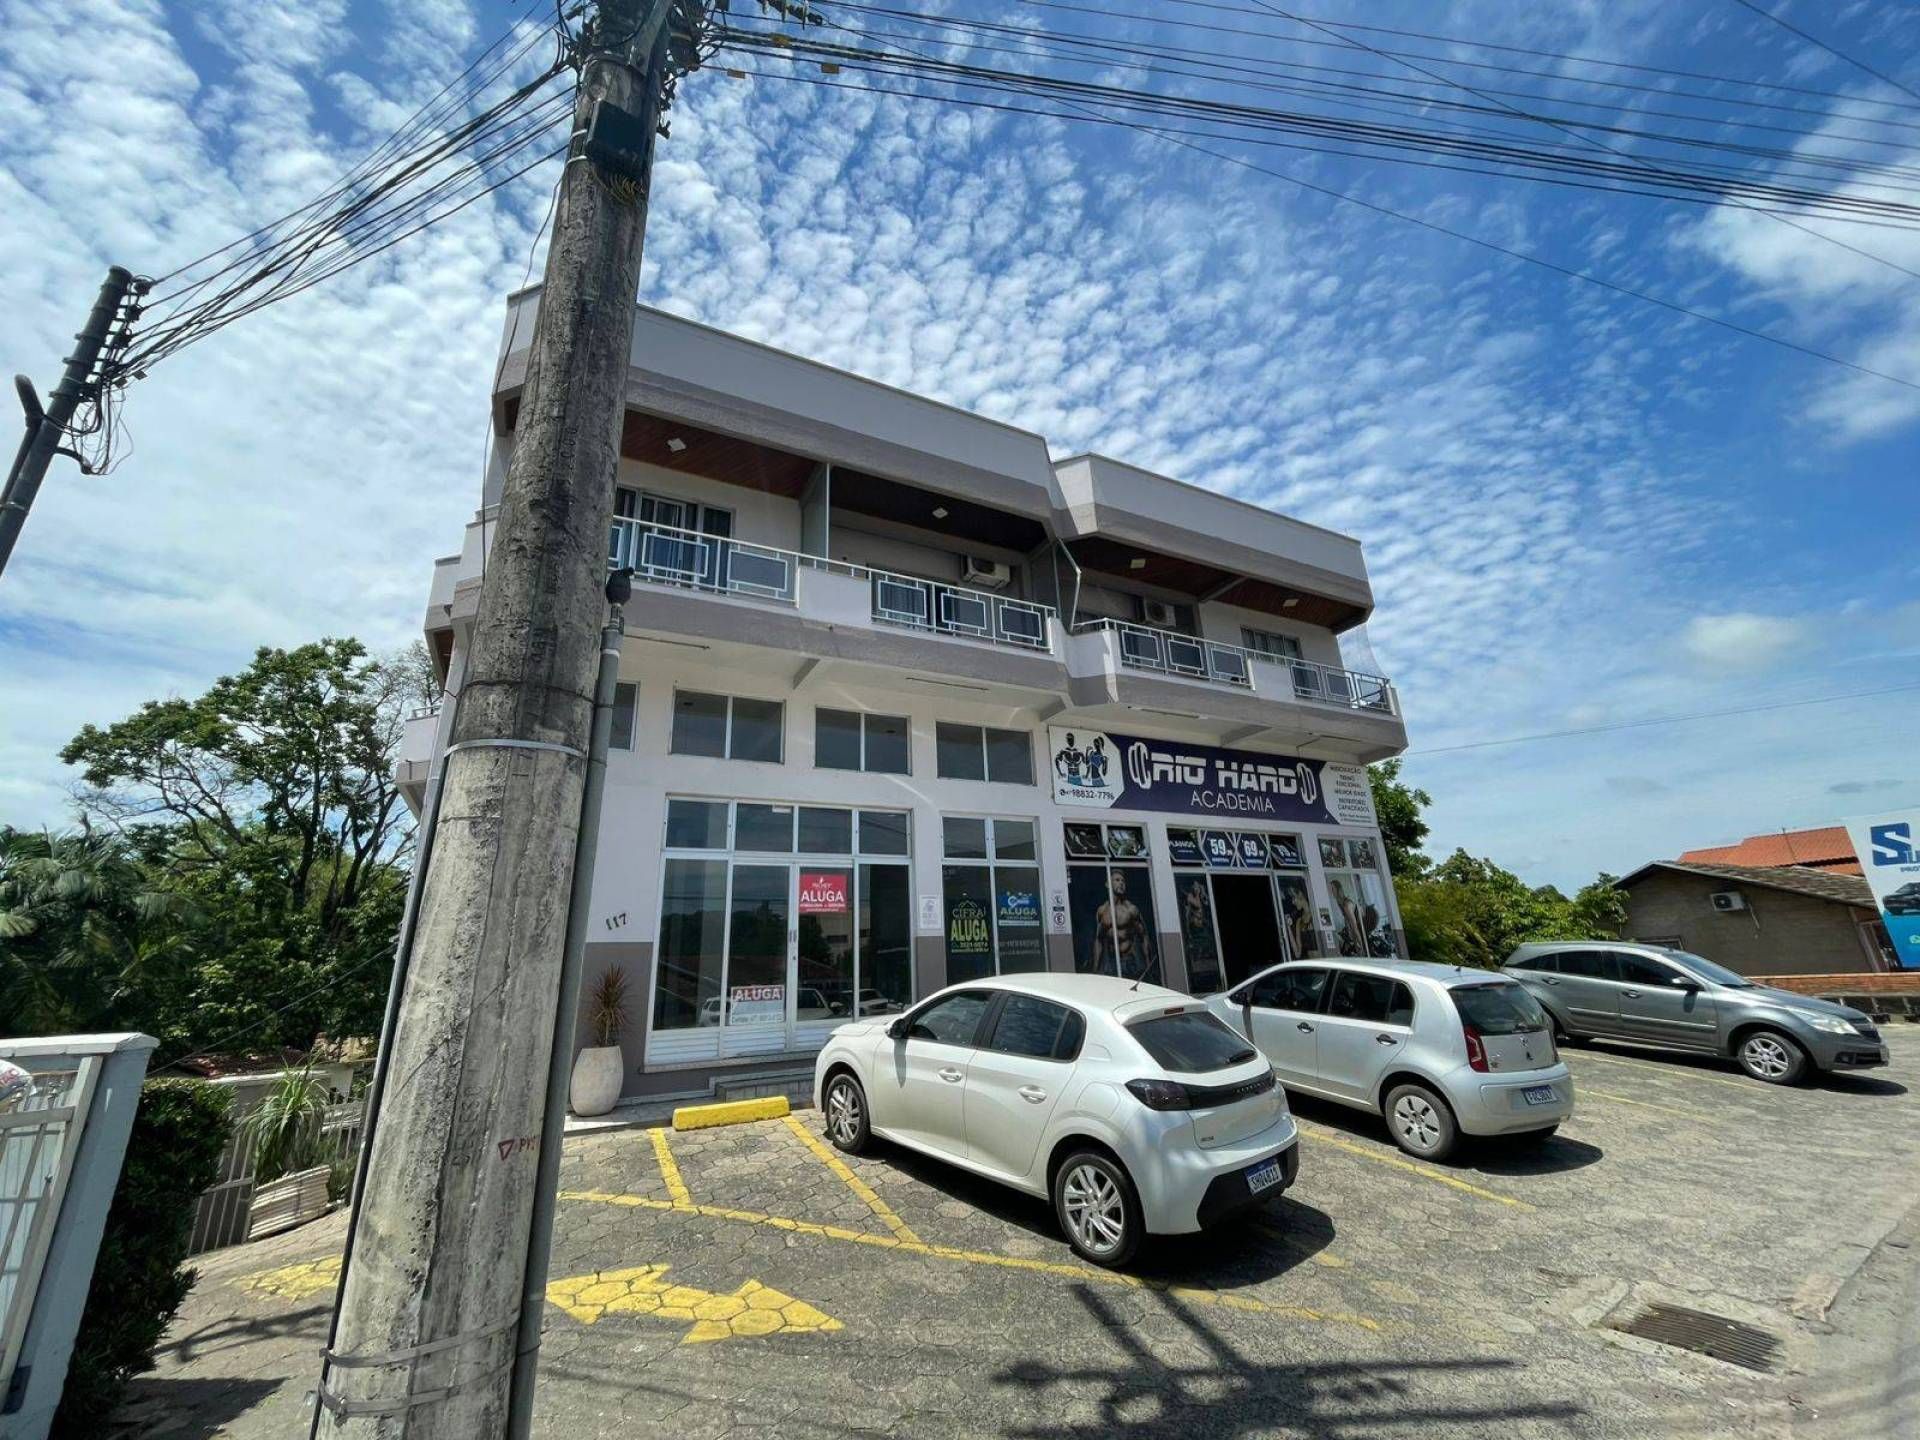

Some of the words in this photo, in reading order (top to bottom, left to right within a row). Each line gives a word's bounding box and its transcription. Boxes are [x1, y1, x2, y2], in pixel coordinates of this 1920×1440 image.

[1151, 752, 1206, 786] RIO
[1215, 760, 1298, 795] HARD
[1190, 790, 1275, 813] ACADEMIA
[801, 890, 845, 902] ALUGA
[1000, 907, 1037, 916] ALUGA
[605, 912, 627, 931] 117
[951, 919, 988, 942] ALUGA
[735, 988, 782, 1001] ALUGA
